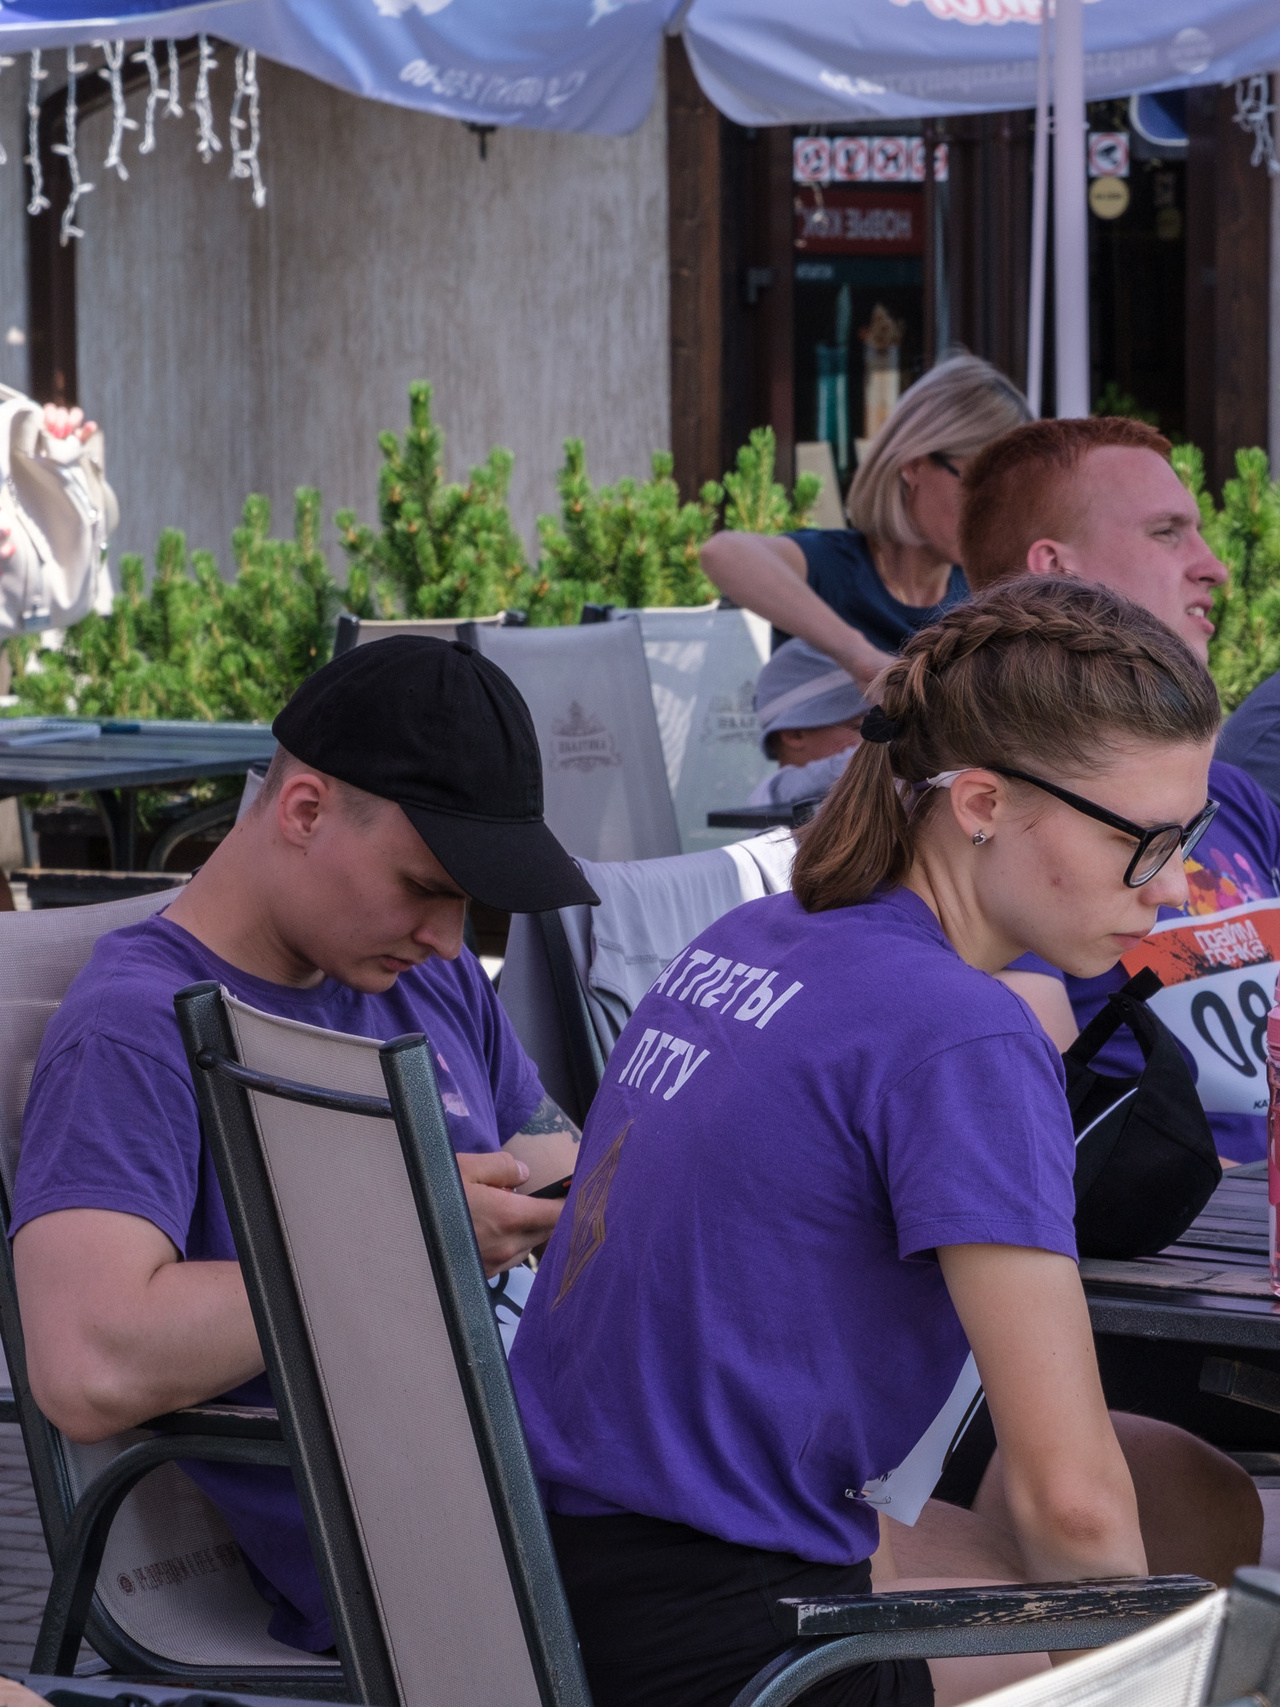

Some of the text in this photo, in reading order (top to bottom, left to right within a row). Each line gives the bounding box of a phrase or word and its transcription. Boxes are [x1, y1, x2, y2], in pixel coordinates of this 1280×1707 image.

[648, 946, 804, 1030] АТЛЕТЫ
[1191, 975, 1280, 1078] 08
[618, 1028, 711, 1101] ЛГТУ
